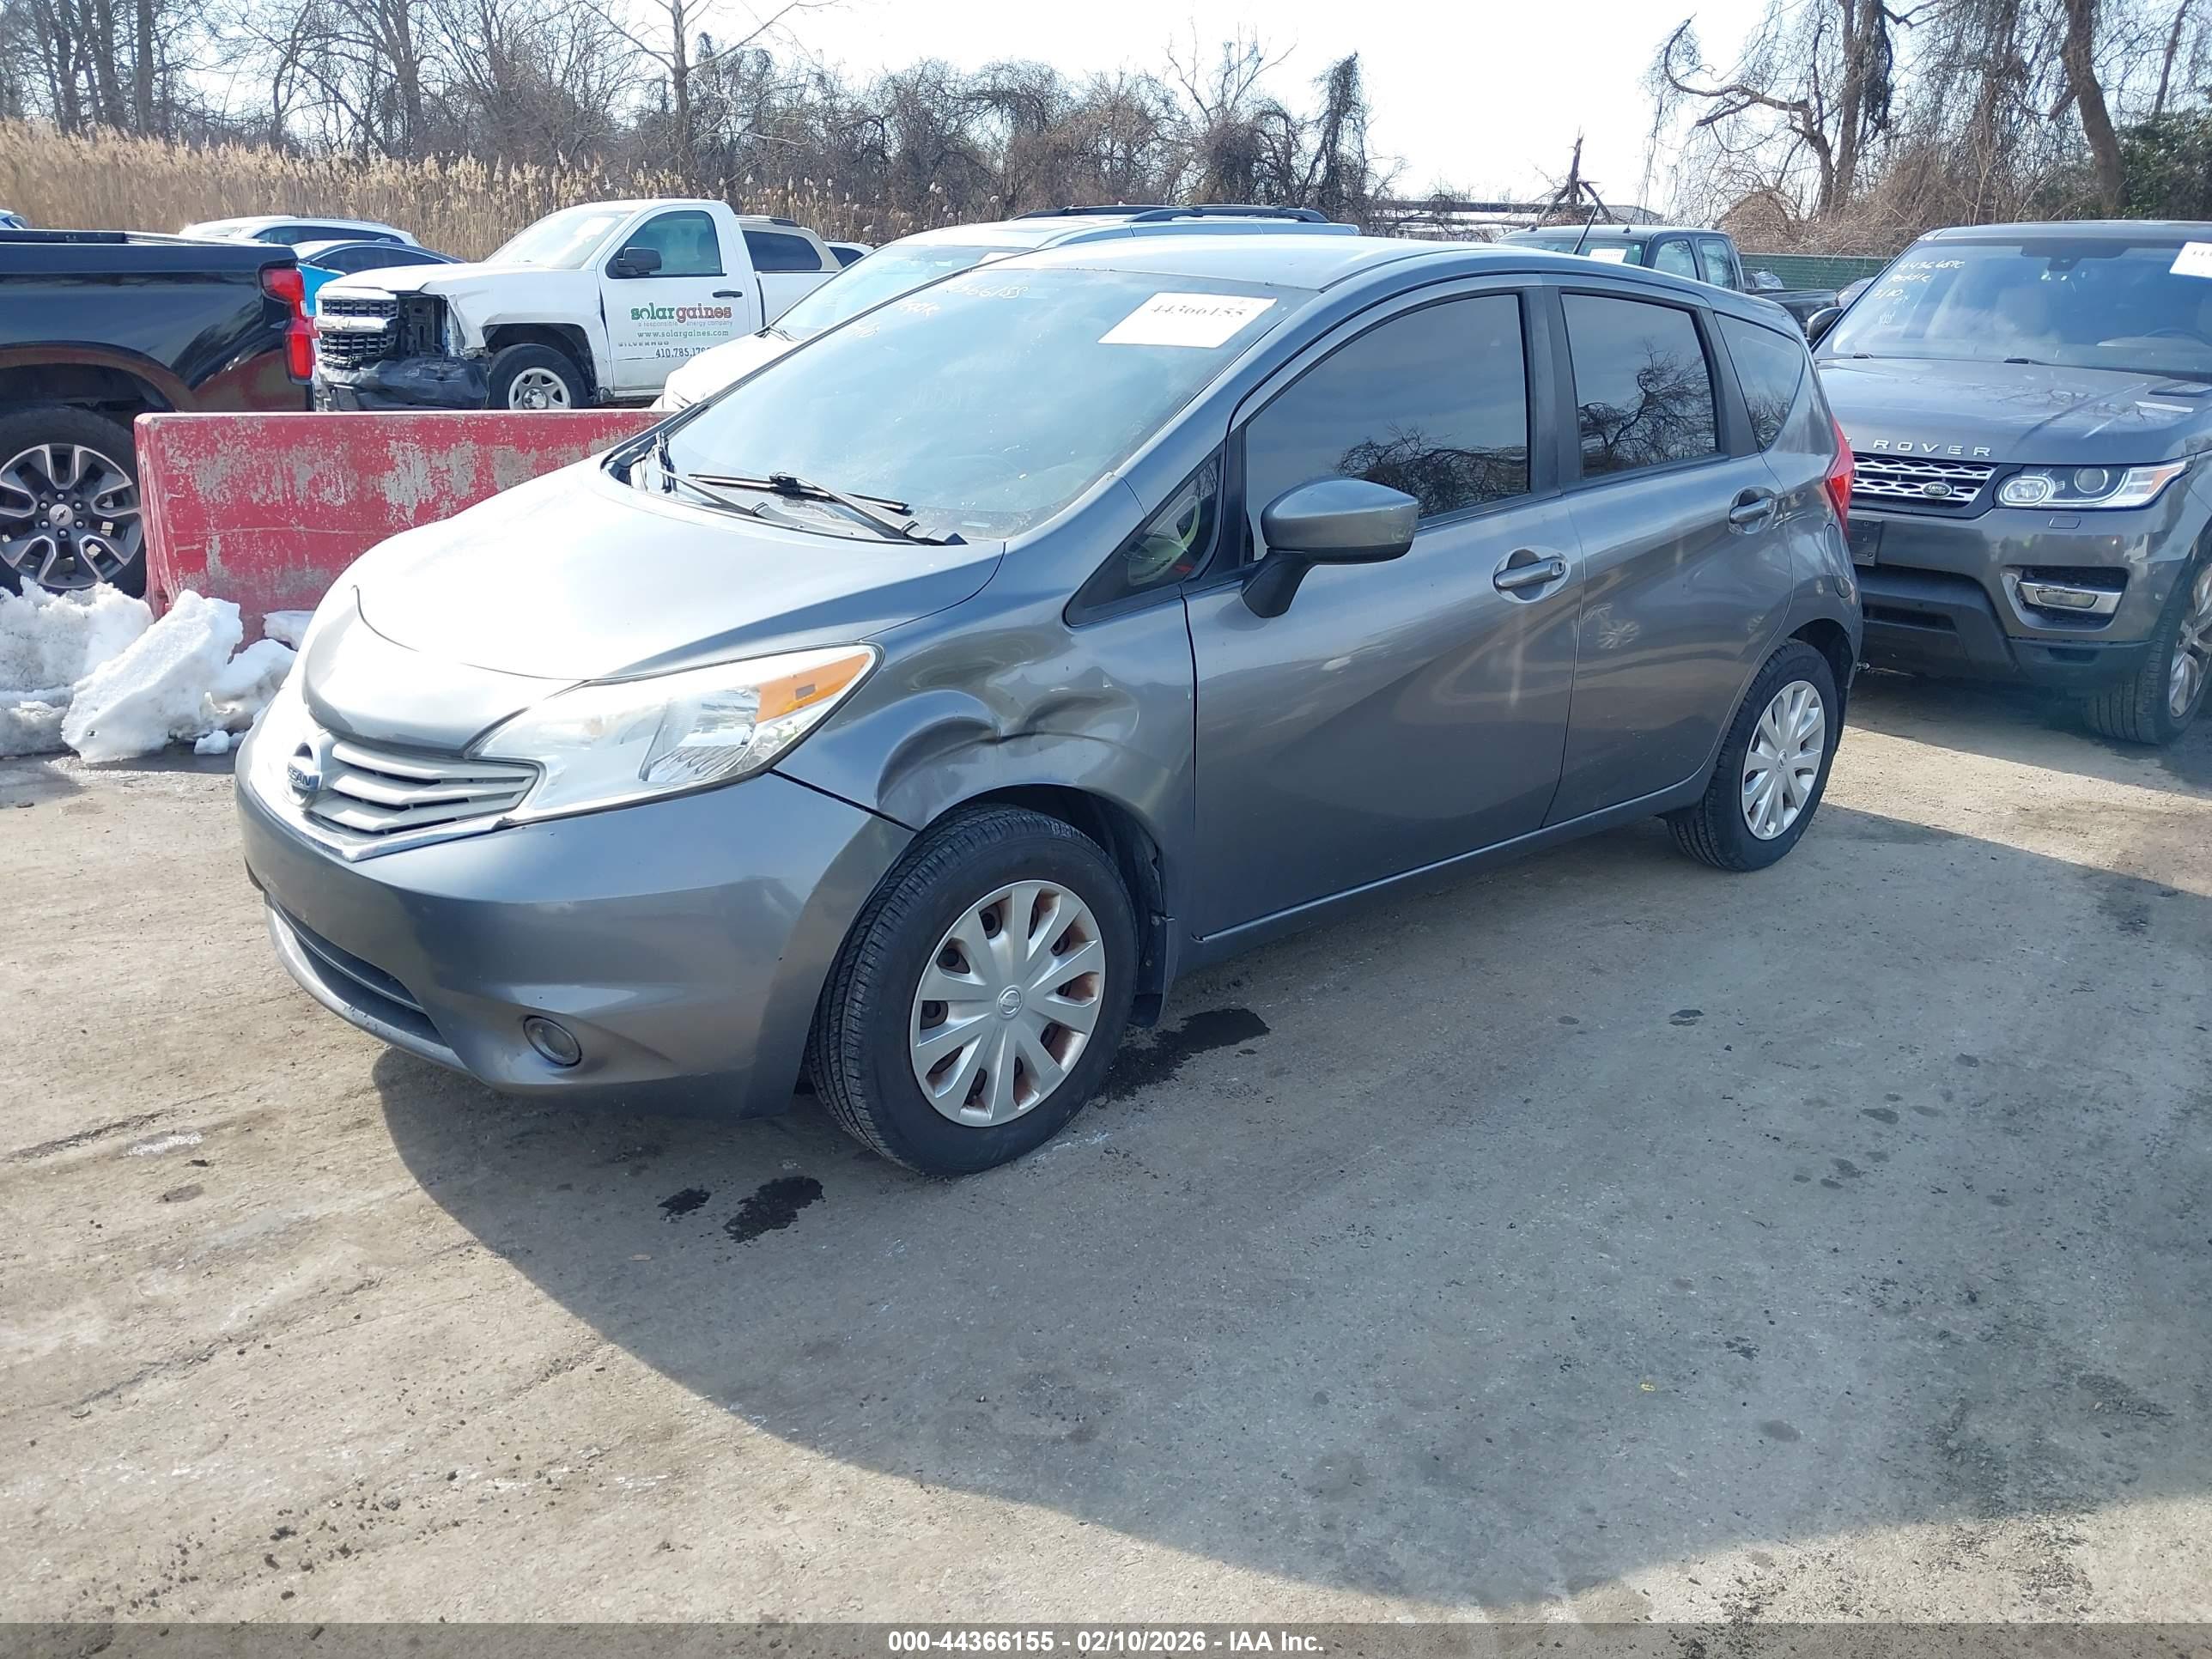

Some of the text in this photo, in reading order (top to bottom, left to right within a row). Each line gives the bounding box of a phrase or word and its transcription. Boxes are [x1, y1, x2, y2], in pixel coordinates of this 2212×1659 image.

[637, 330, 729, 338] www.solargaines.com
[655, 347, 711, 358] 410.785.17
[1873, 440, 1991, 457] ROVER
